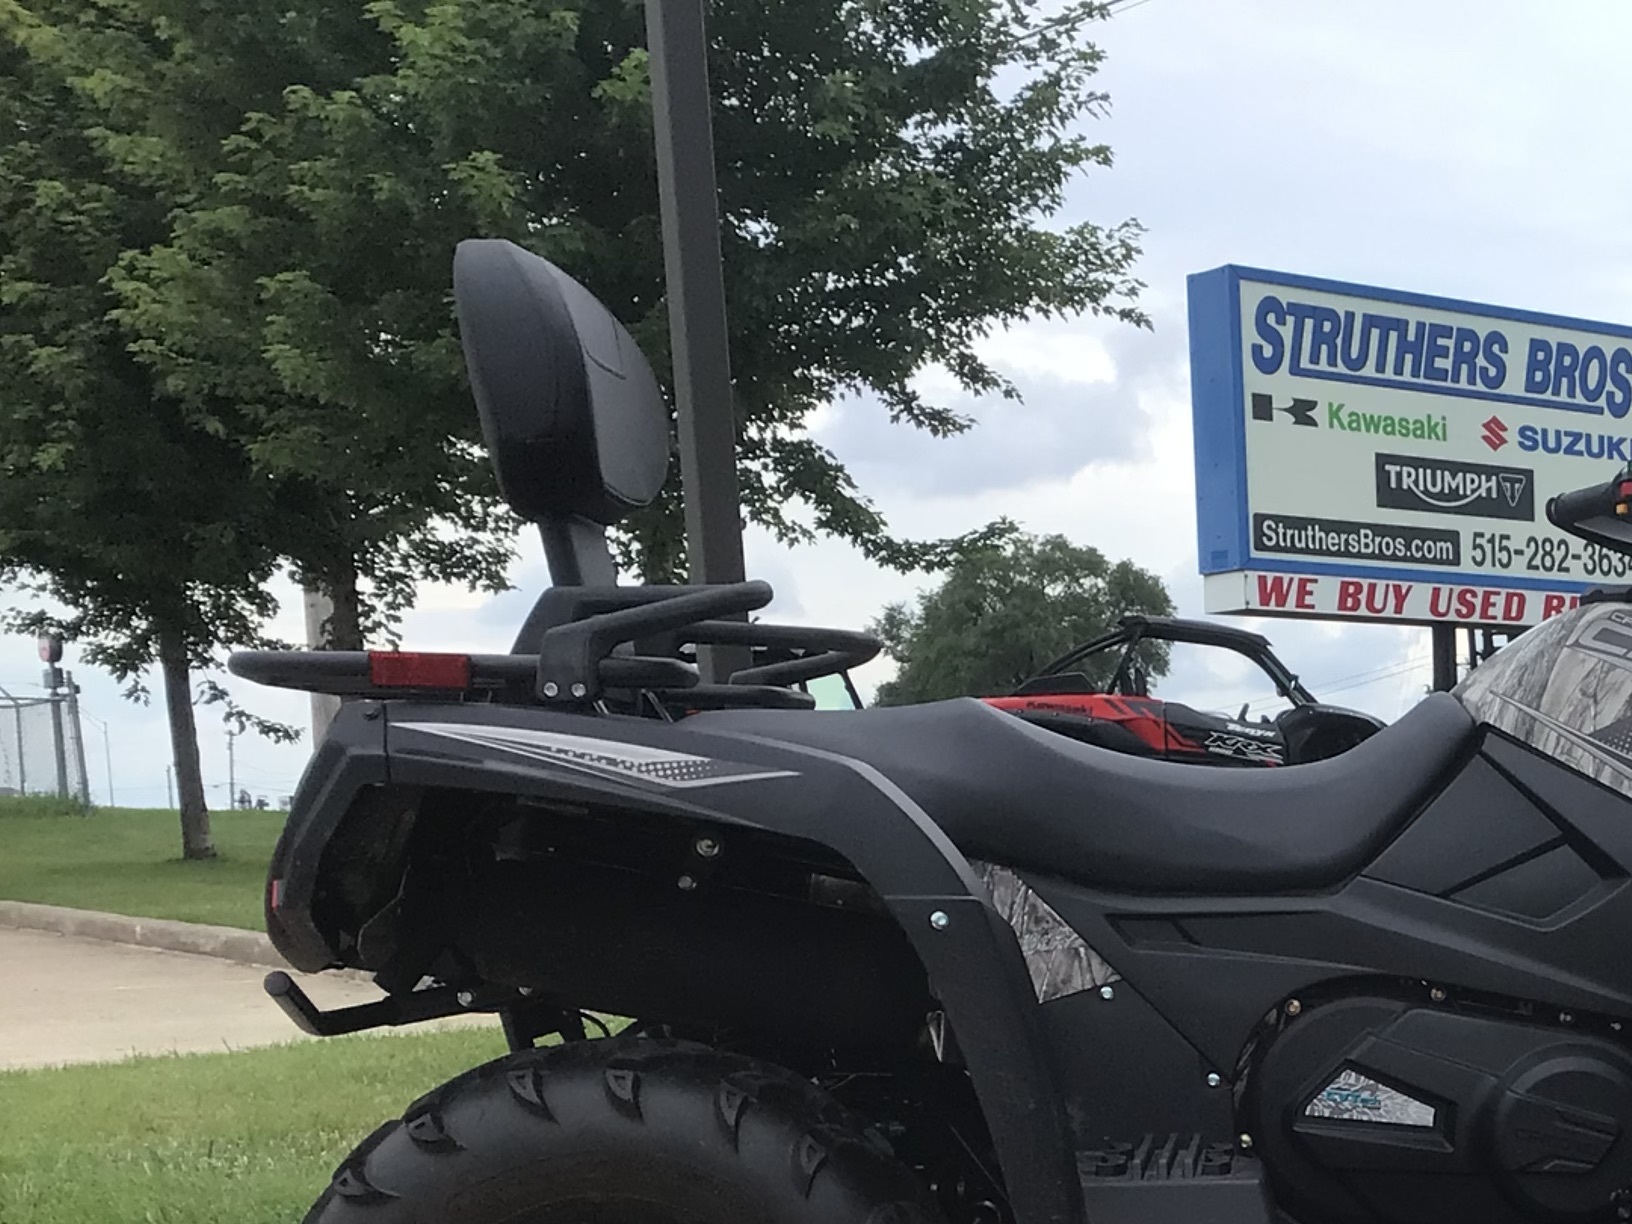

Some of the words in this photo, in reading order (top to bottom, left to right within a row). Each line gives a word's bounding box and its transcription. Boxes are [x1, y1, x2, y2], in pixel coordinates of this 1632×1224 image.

[1252, 296, 1508, 390] STRUTHERS
[1327, 402, 1448, 442] Kawasaki
[1384, 464, 1498, 507] TRIUMPH
[1261, 520, 1454, 562] StruthersBros.com
[1257, 575, 1319, 610] WE
[1337, 580, 1414, 616] BUY
[1429, 586, 1527, 622] USED
